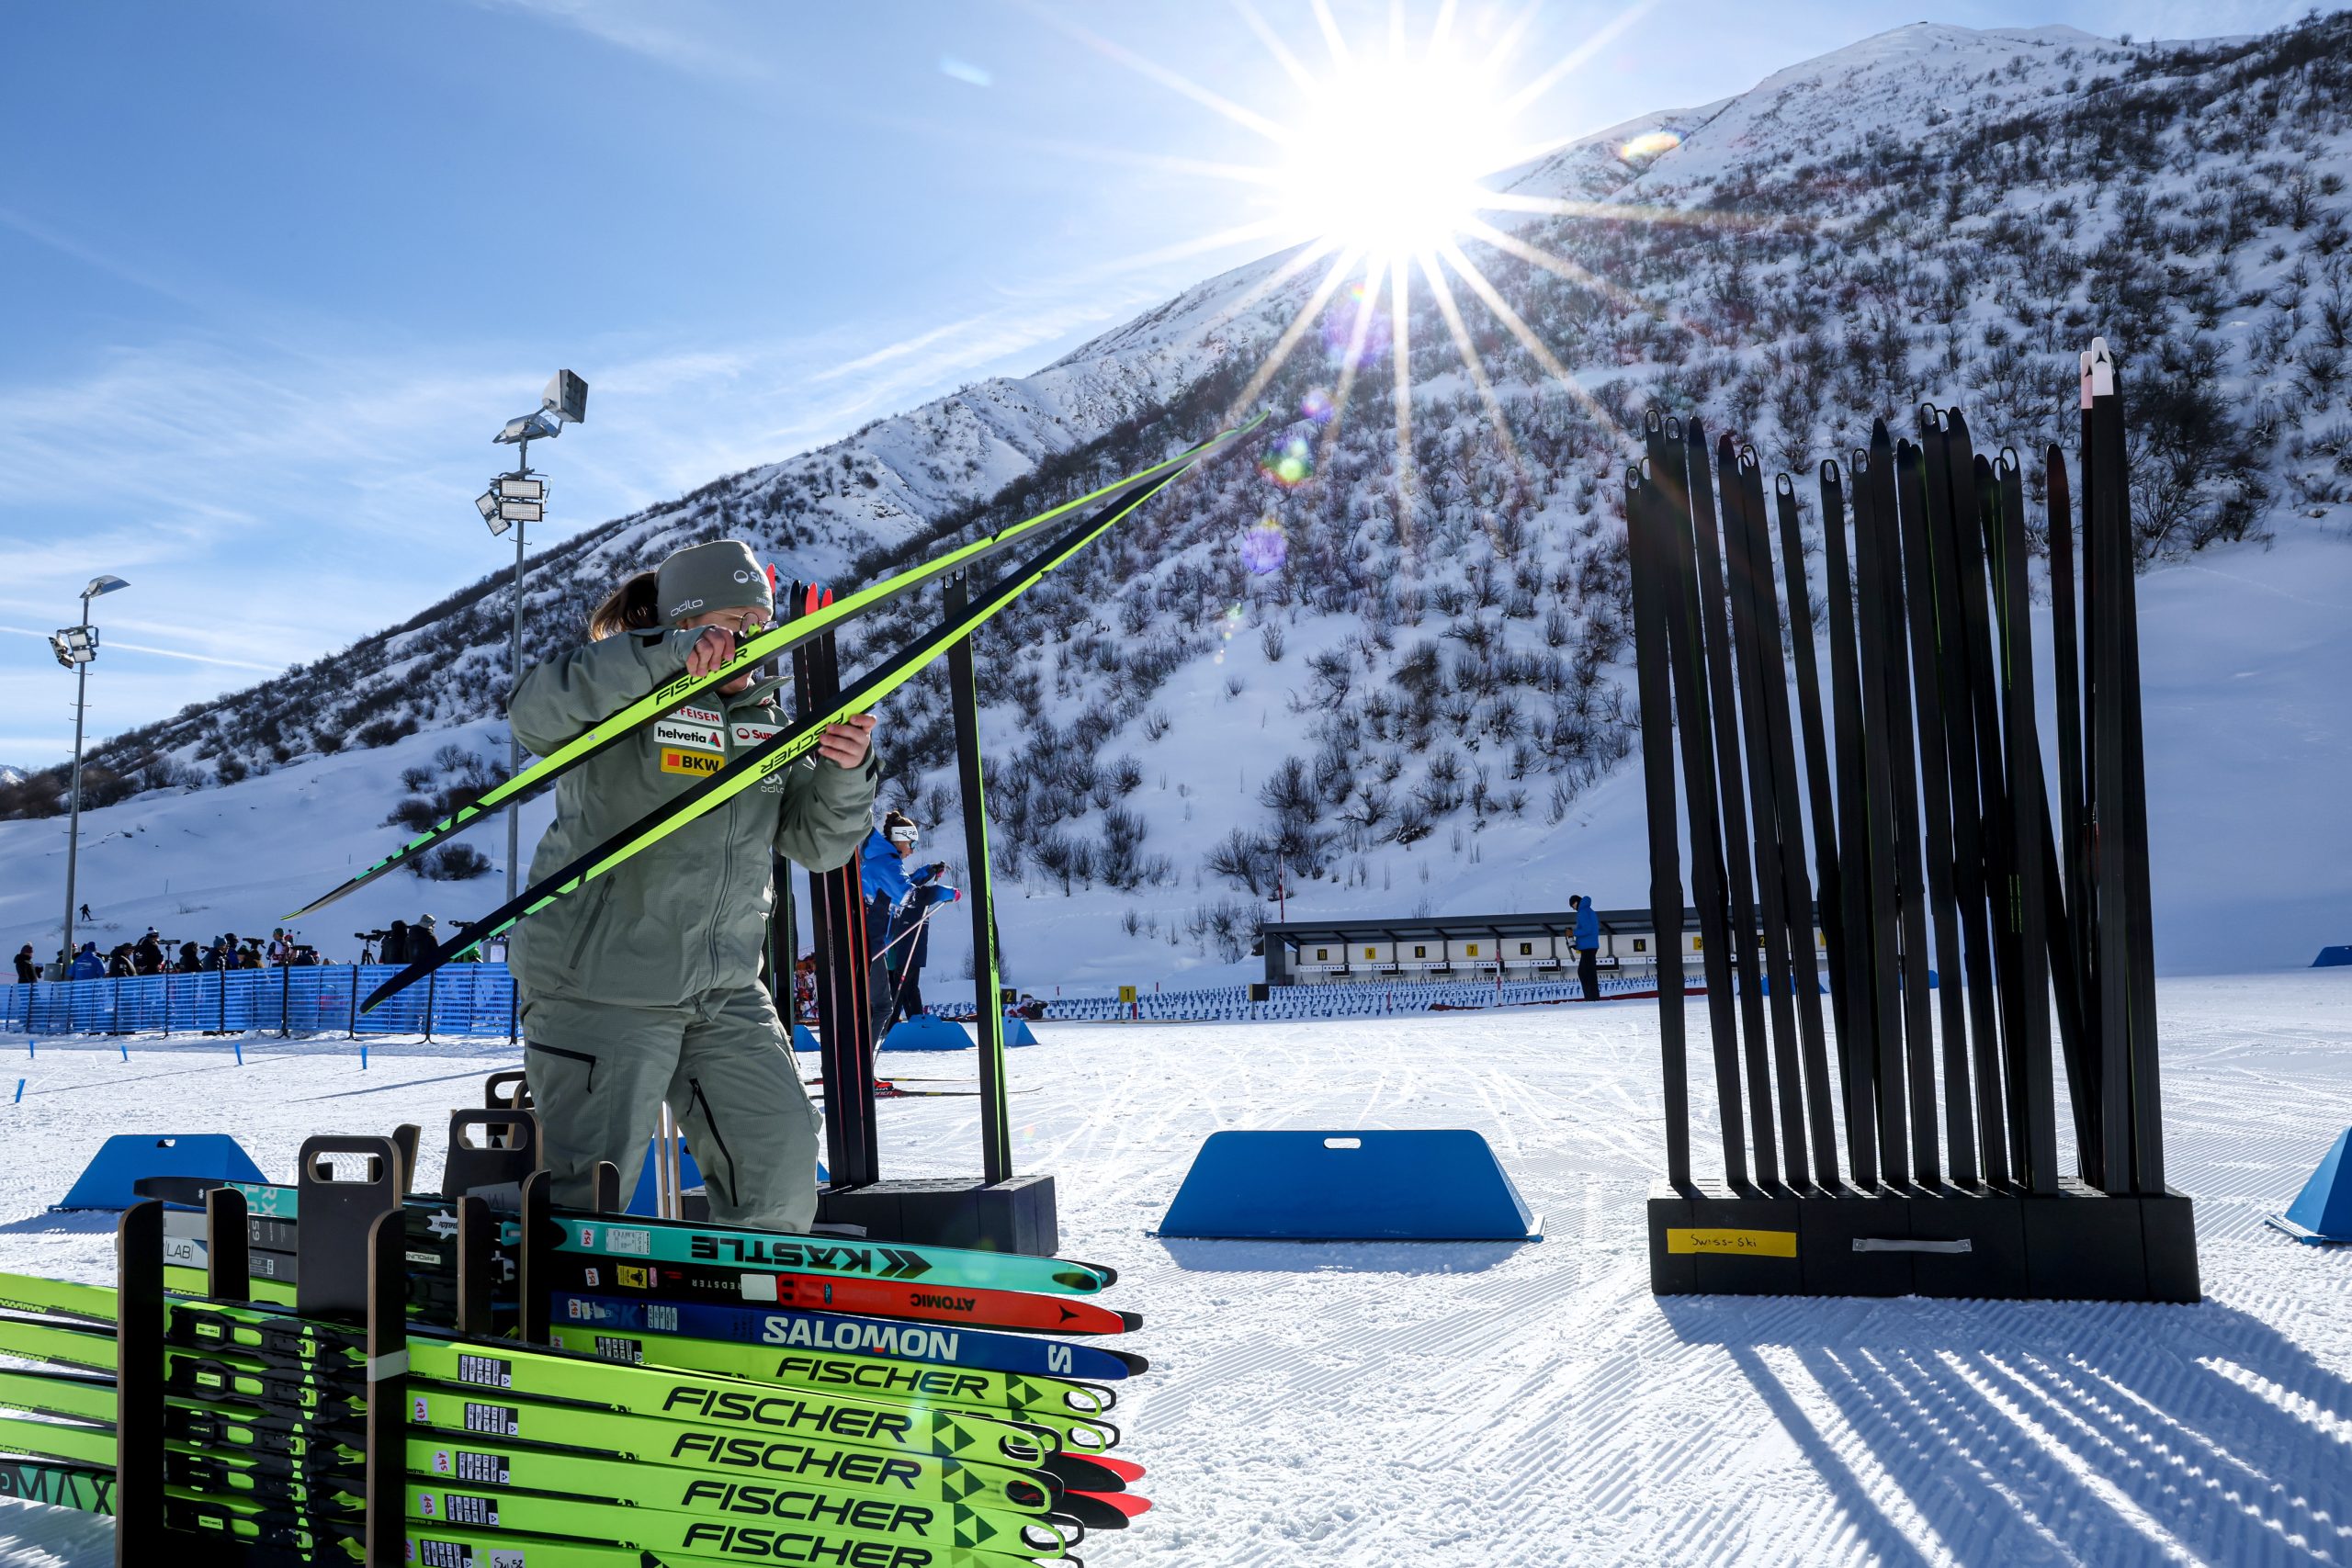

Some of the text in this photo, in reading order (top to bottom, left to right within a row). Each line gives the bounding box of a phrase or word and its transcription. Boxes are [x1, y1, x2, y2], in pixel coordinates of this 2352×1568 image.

[670, 599, 704, 617] odlo
[656, 647, 748, 705] FISCER
[657, 727, 707, 744] helvetia
[682, 755, 719, 772] BKW
[1368, 949, 1373, 958] 9
[1418, 947, 1423, 957] 8
[1470, 946, 1475, 955] 7
[1523, 944, 1529, 953] 6
[1637, 941, 1643, 950] 4
[1317, 950, 1326, 960] 10
[1006, 991, 1012, 1001] 2
[910, 1292, 977, 1312] ATOMIC
[762, 1315, 959, 1361] SALOMON
[1047, 1344, 1072, 1373] S
[775, 1357, 989, 1400] FISCHER
[662, 1386, 913, 1445] FISCHER
[670, 1431, 922, 1490] FISCHER
[681, 1480, 934, 1537] FISCHER
[682, 1522, 933, 1568] FISCHER
